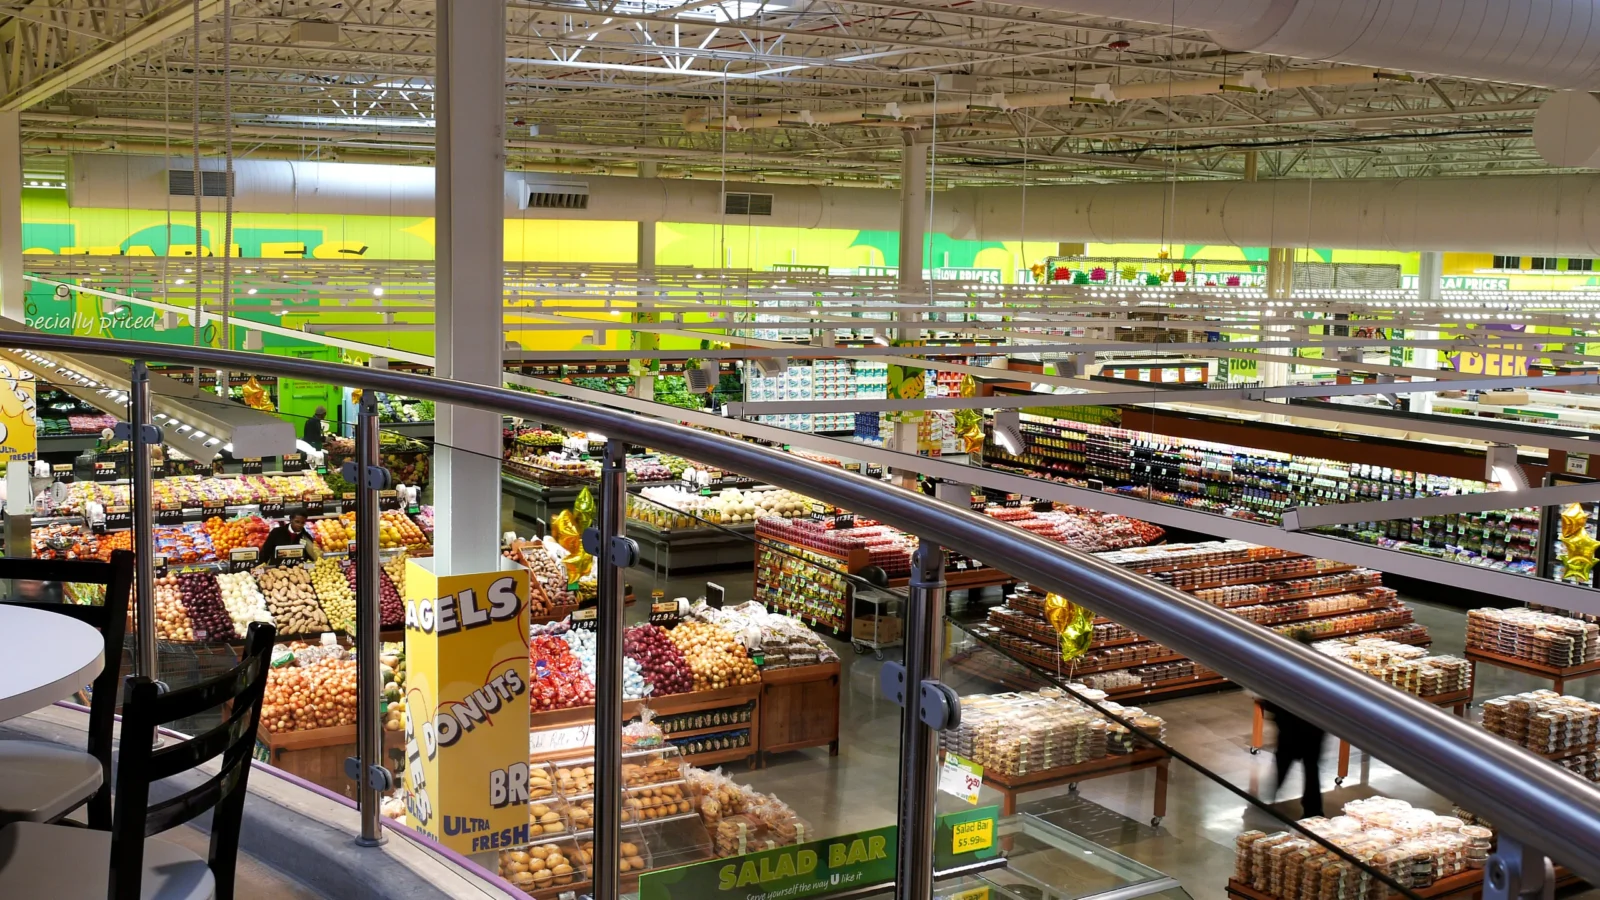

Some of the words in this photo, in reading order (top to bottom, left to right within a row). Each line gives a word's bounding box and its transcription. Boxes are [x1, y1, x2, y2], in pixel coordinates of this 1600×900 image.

[99, 311, 156, 334] priced
[421, 668, 526, 763] DONUTS
[443, 815, 491, 837] ULTRA
[472, 823, 529, 852] FRESH
[955, 821, 976, 835] Salad
[976, 820, 989, 831] Bar
[718, 850, 818, 891] SALAD
[828, 835, 887, 868] BAR
[767, 883, 800, 900] yourself
[799, 882, 813, 894] the
[812, 880, 829, 891] way
[830, 873, 840, 885] U
[841, 873, 855, 884] like
[855, 870, 863, 881] it
